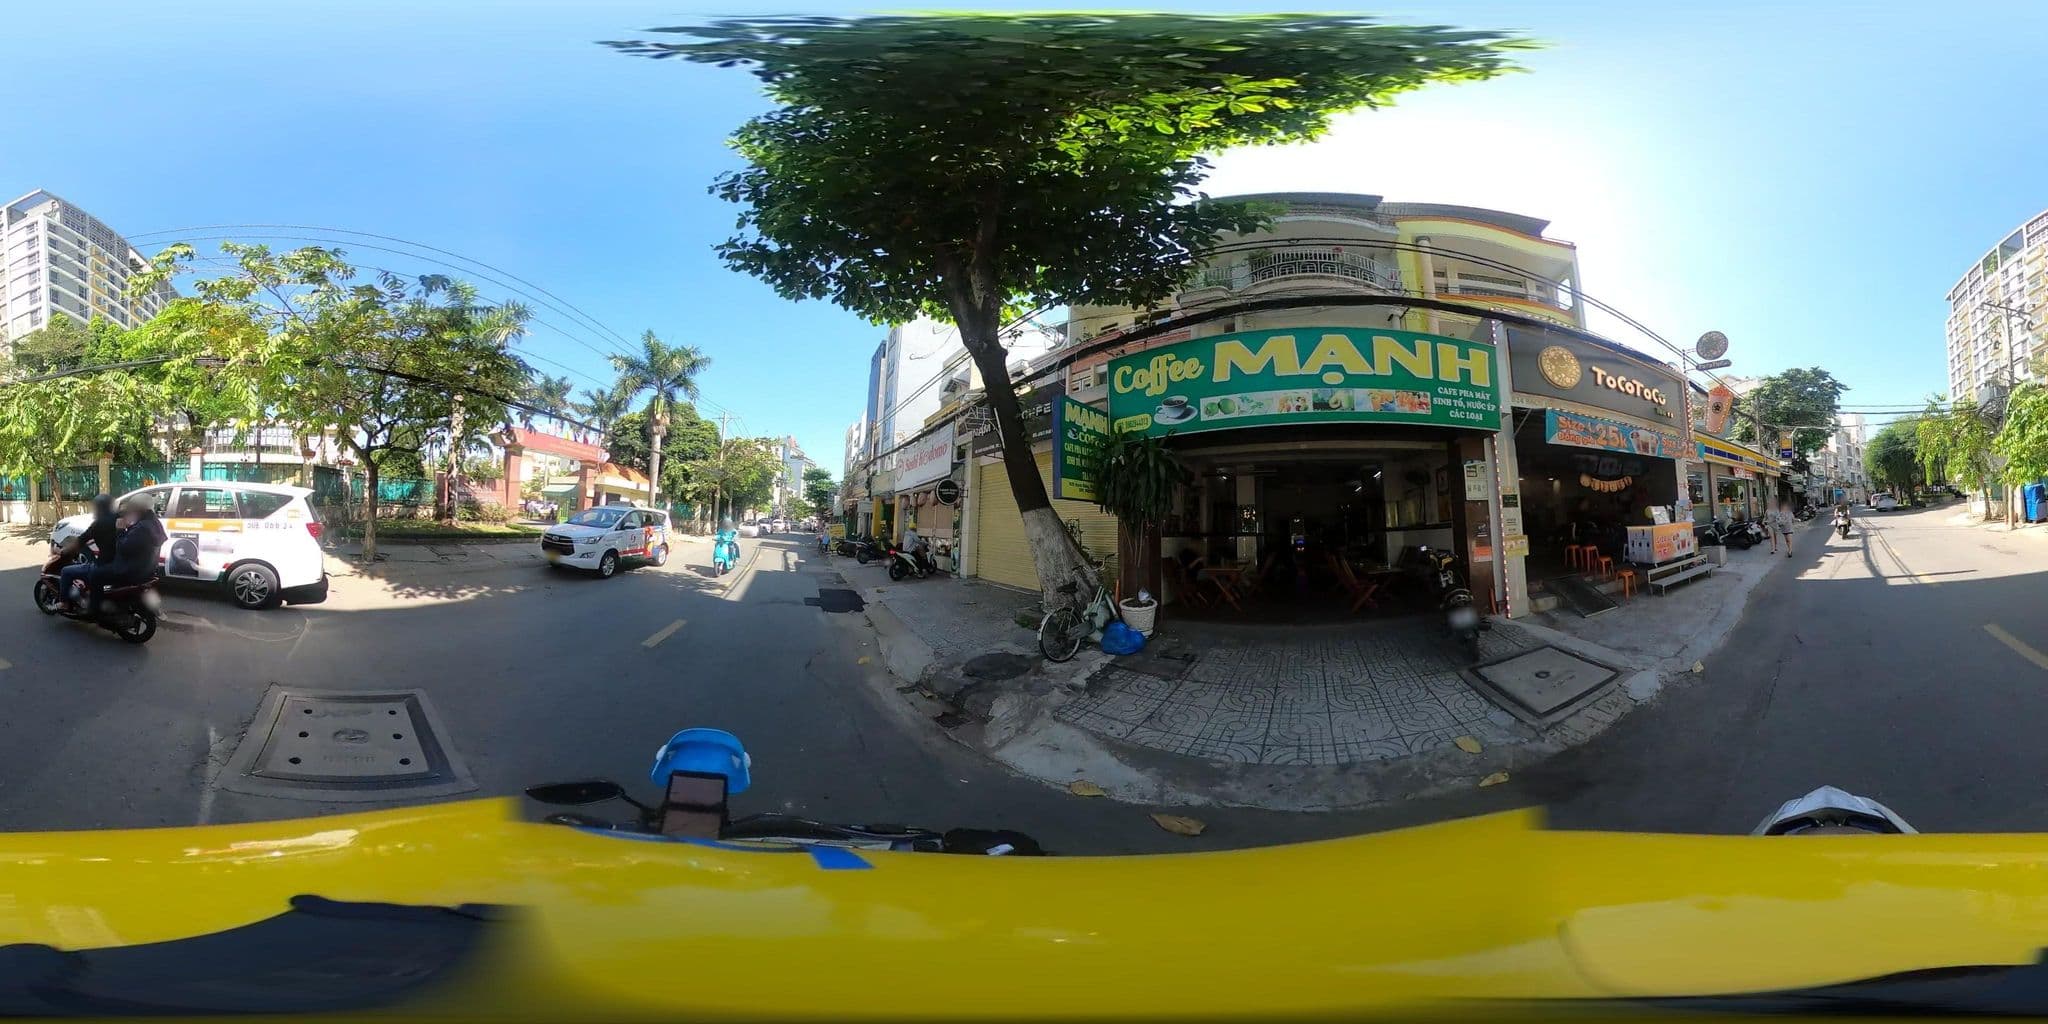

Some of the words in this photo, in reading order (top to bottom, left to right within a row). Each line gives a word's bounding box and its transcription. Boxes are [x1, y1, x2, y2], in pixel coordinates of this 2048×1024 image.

[1211, 333, 1491, 388] MẠNH
[1113, 353, 1204, 397] Coffee
[1437, 386, 1458, 396] CAFE
[1459, 389, 1474, 398] PHA
[1475, 390, 1491, 400] MÁY
[1433, 397, 1452, 406] SINH
[1065, 402, 1108, 435] MẠNH
[1449, 409, 1465, 418] CÁC
[1466, 411, 1483, 422] LOẠI
[1558, 416, 1585, 431] Size
